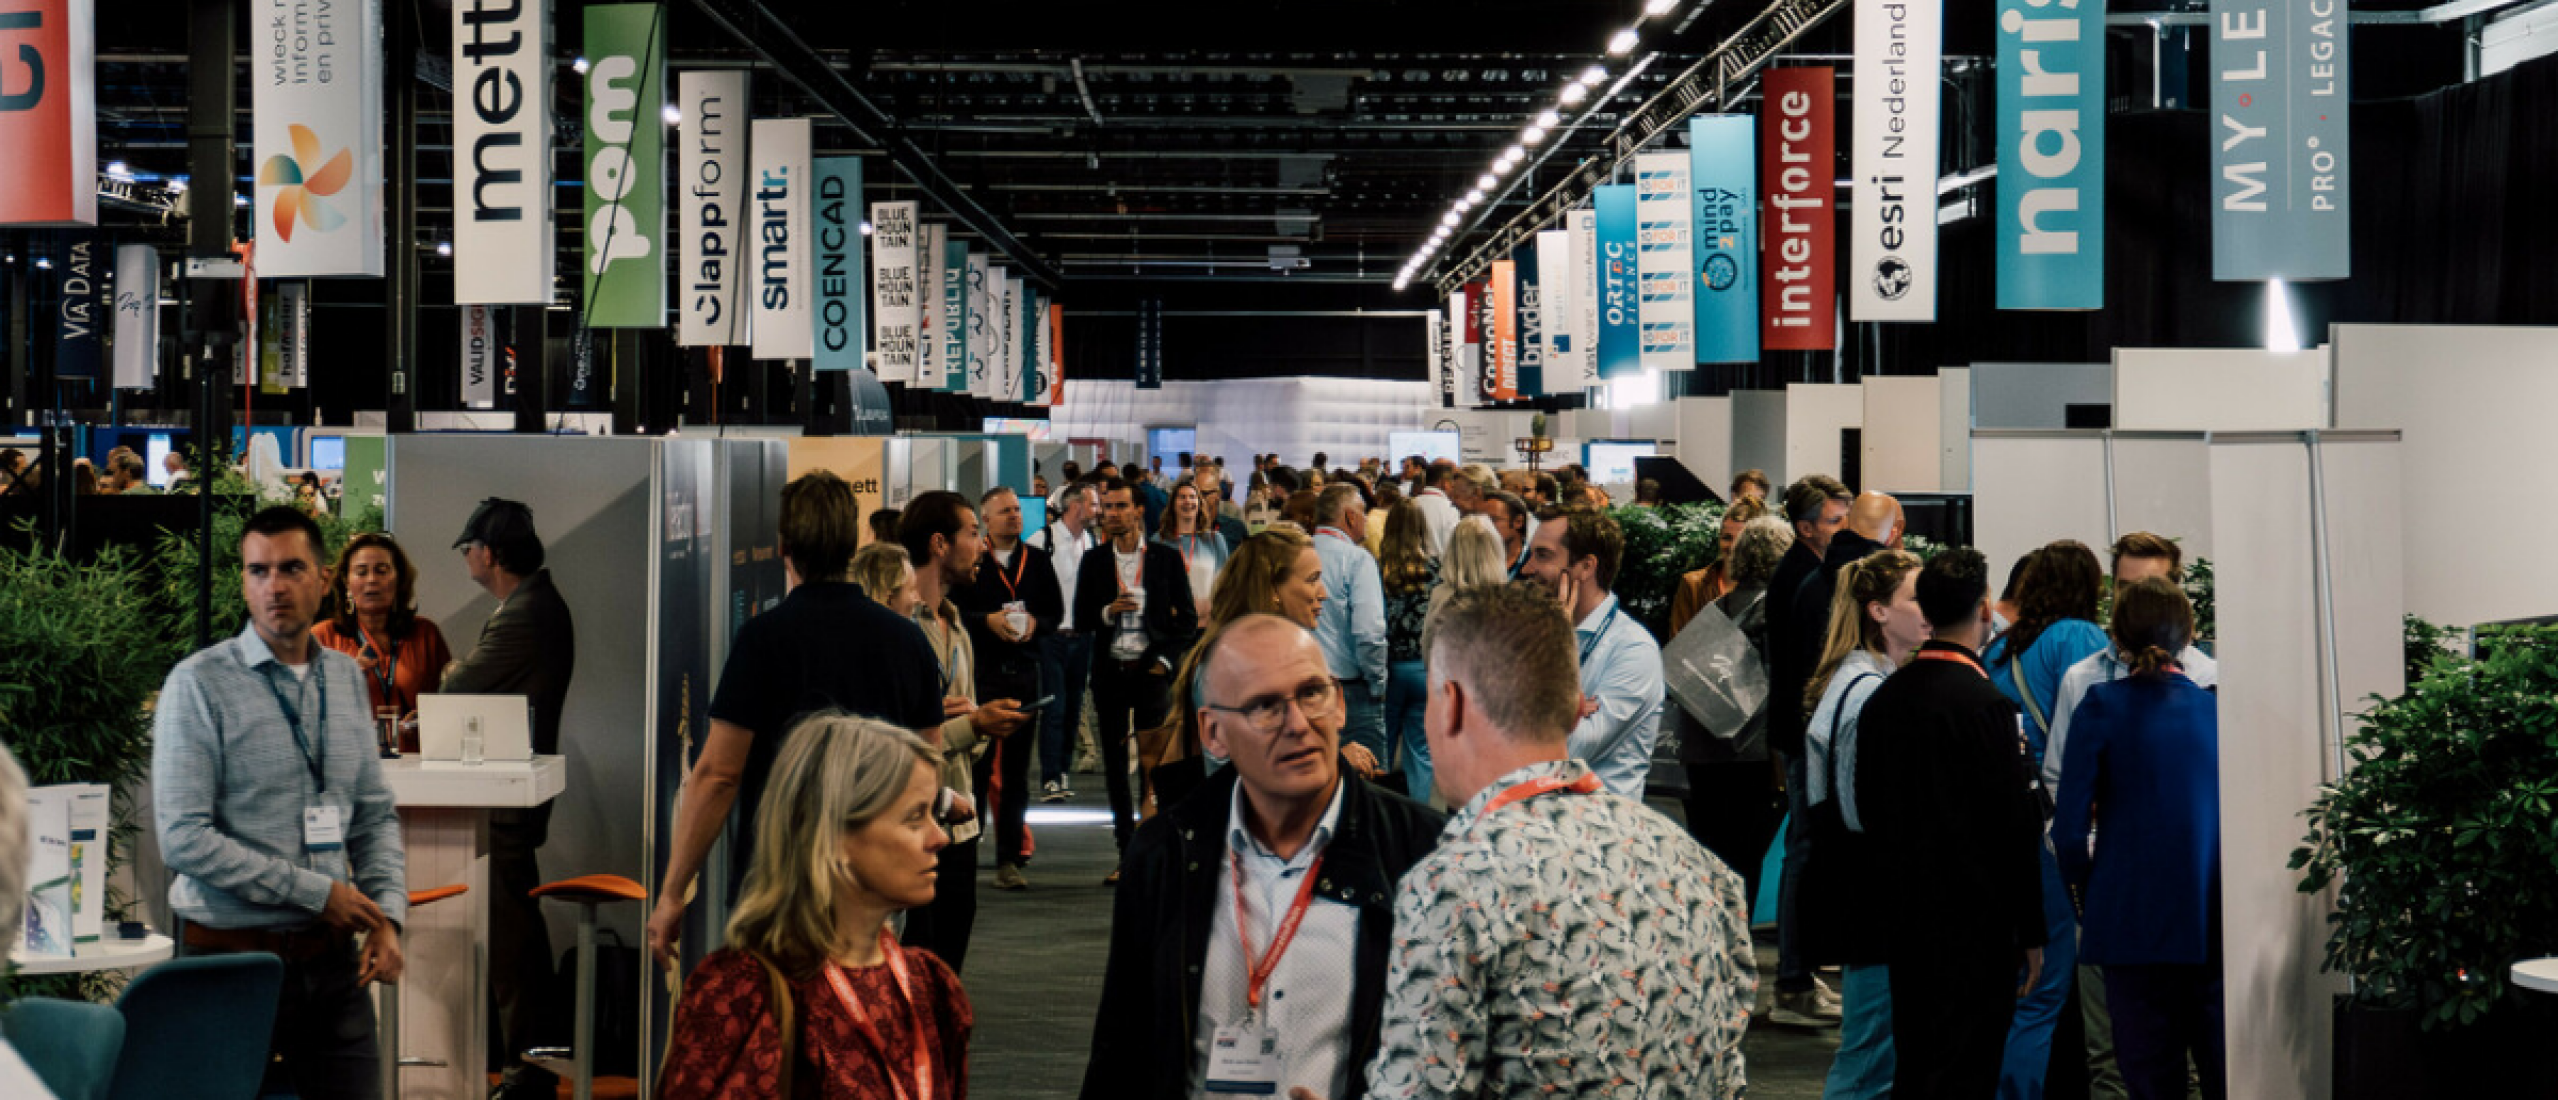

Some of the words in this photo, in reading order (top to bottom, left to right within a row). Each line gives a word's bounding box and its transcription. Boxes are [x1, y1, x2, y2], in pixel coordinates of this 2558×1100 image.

[271, 15, 285, 86] wieck
[317, 55, 330, 84] en
[1882, 3, 1906, 157] Nederland
[2001, 0, 2081, 254] nari
[590, 55, 650, 275] pom
[876, 222, 911, 234] MOUN
[878, 209, 908, 220] BLUE
[1697, 188, 1717, 249] mind
[1772, 90, 1823, 327] interforce
[1872, 176, 1904, 251] esri
[820, 175, 847, 351] COENCAD
[878, 281, 913, 293] MOUN
[879, 266, 910, 279] BLUE
[879, 339, 914, 352] MOUN
[880, 325, 911, 338] BLUE
